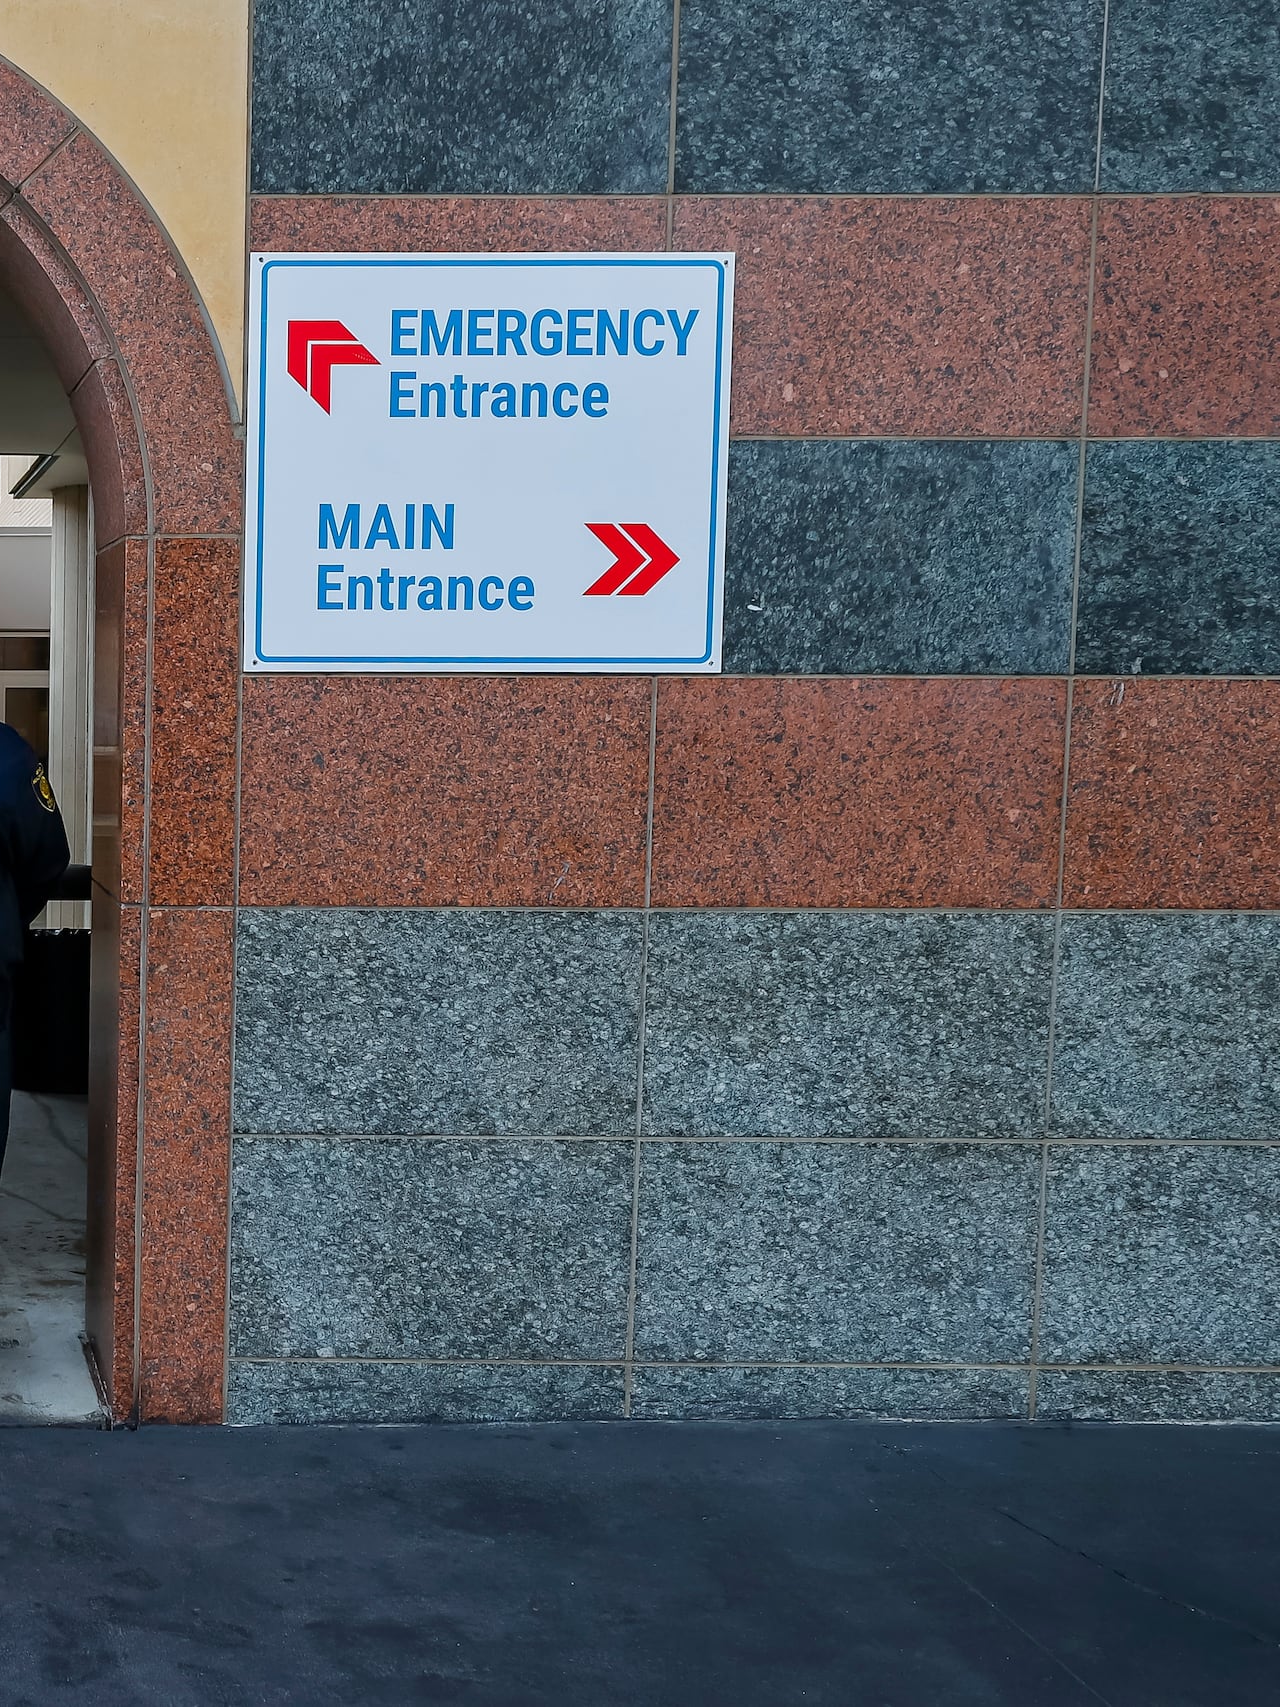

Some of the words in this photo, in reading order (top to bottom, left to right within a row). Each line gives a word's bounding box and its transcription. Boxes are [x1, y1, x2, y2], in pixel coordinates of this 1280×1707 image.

[390, 308, 700, 357] EMERGENCY
[389, 371, 609, 418] Entrance
[318, 503, 455, 550] MAIN
[317, 564, 535, 611] Entrance
